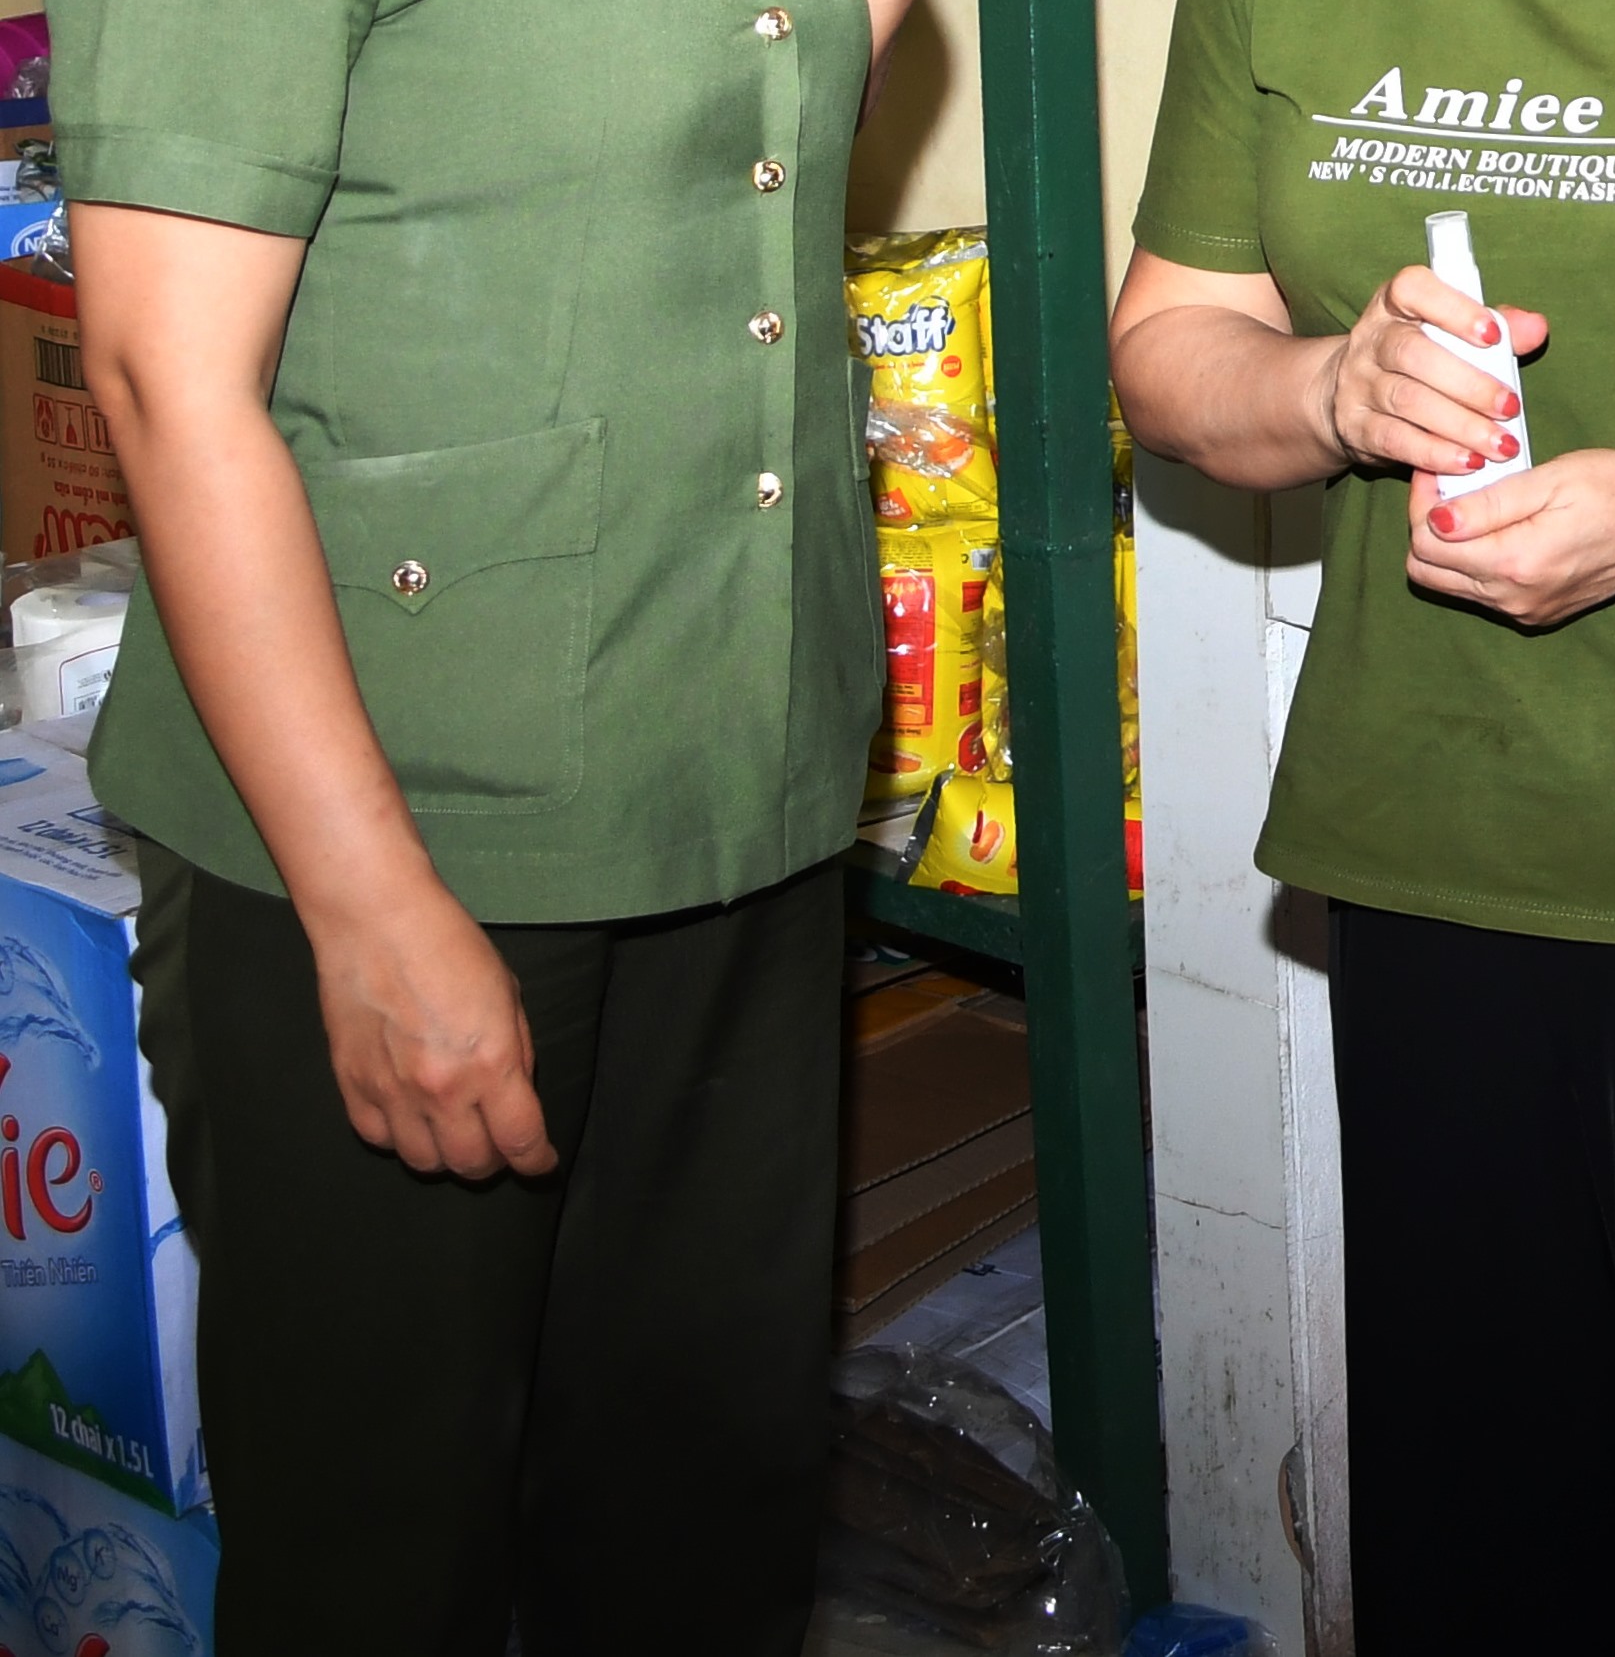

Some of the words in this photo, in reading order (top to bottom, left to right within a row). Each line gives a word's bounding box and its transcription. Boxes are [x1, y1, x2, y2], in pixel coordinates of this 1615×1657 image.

[1331, 136, 1473, 172] MODERN
[1390, 168, 1554, 199] COLLECTION
[856, 305, 947, 357] Staff
[1, 1254, 47, 1287] Thiên
[49, 1253, 98, 1285] Nhiên
[50, 1403, 69, 1439] 12
